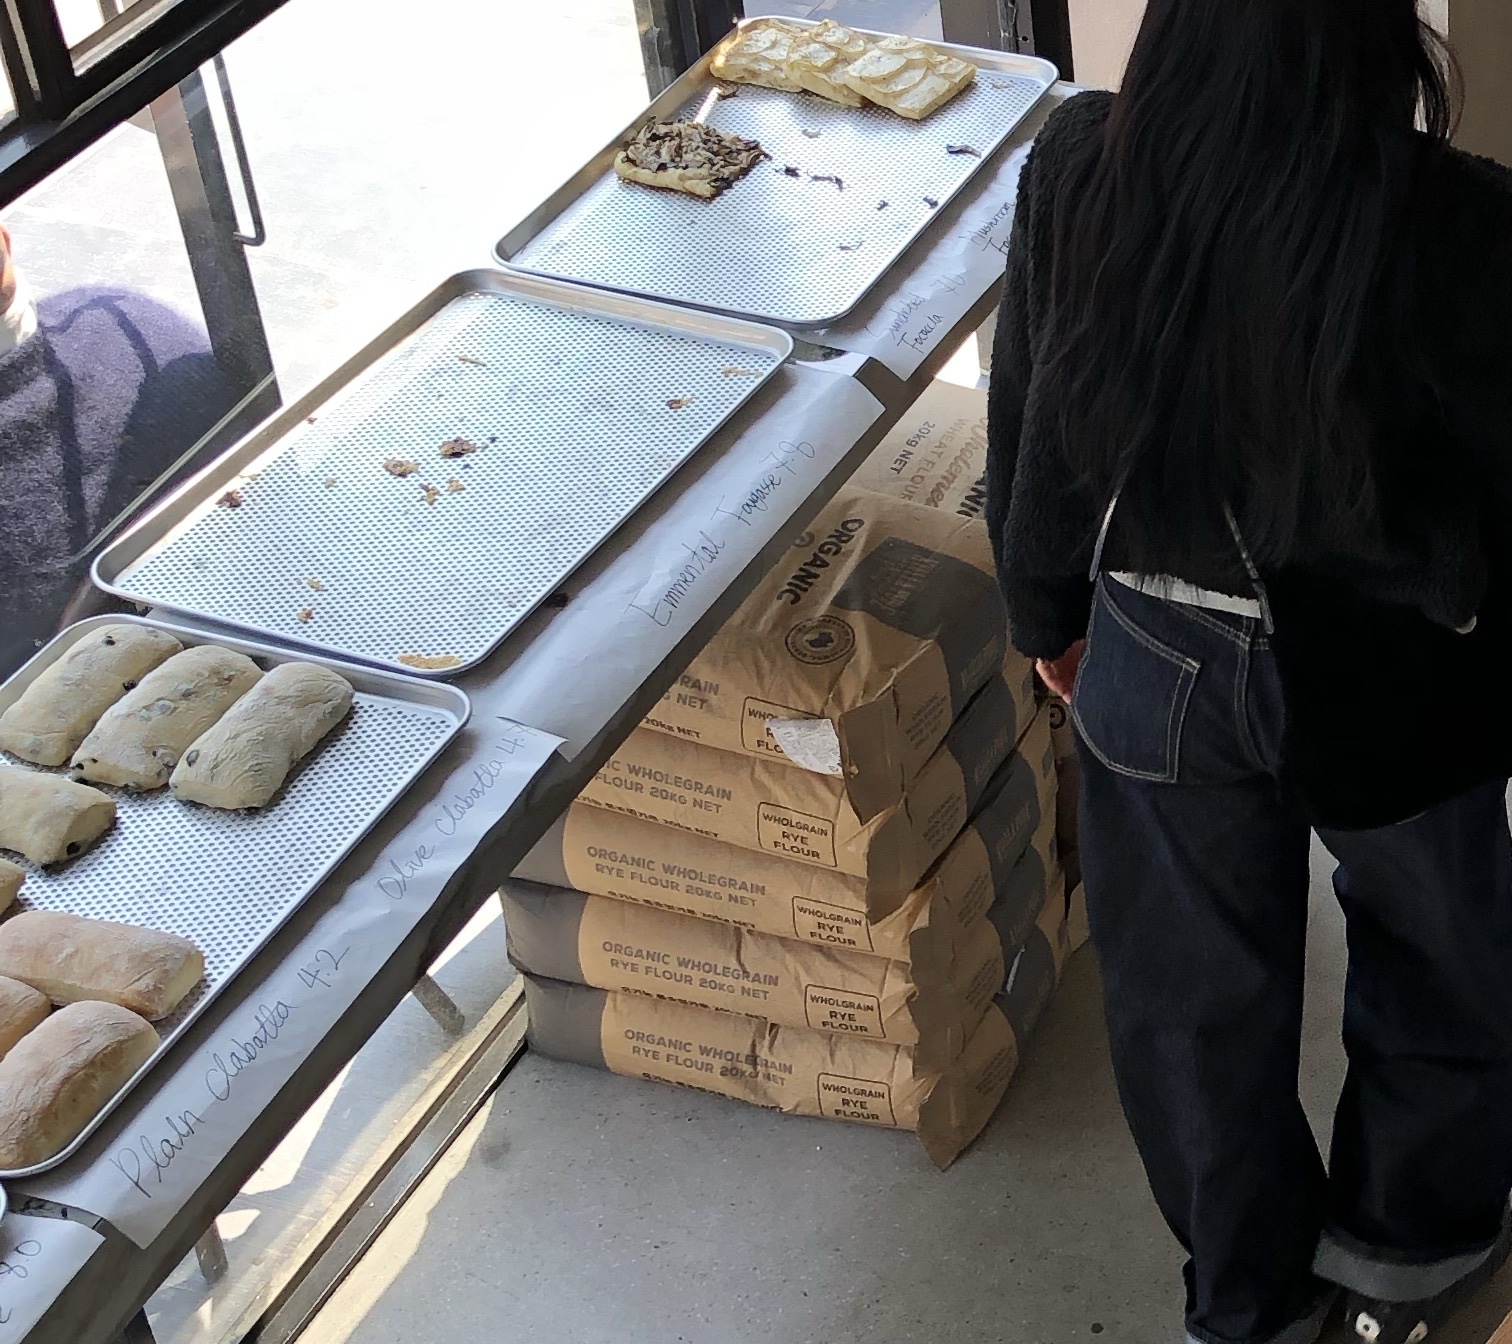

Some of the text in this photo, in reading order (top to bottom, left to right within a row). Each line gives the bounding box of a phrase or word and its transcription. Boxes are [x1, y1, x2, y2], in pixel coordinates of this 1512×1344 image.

[889, 420, 936, 475] 20kg NET
[775, 515, 867, 607] ORGANIC
[676, 693, 709, 711] NET
[626, 762, 733, 802] WHOLEGRAIN
[693, 797, 723, 815] NET
[773, 841, 821, 860] FLOUR
[781, 831, 810, 846] RYE
[377, 841, 435, 901] Olive
[586, 845, 767, 897] ORGANIC WHOLEGRAIN
[594, 862, 626, 879] RYE
[629, 871, 681, 893] FLOUR
[728, 894, 758, 909] NET
[809, 930, 857, 947] FLOUR
[816, 921, 845, 935] RYE
[601, 940, 780, 988] ORGANIC WHOLEGRAIN
[609, 957, 639, 974] RYE
[644, 965, 694, 986] FLOUR
[740, 986, 770, 1001] NET
[821, 1019, 869, 1034] FLOUR
[828, 1009, 857, 1023] RYE
[110, 1104, 206, 1200] Plain
[298, 944, 352, 1006] 4.2
[623, 1028, 794, 1076] ORGANIC WHOLEGRAIN
[631, 1045, 661, 1062] RYE
[666, 1053, 715, 1076] FLOUR
[762, 1071, 786, 1088] NET
[834, 1108, 881, 1122] FLOUR
[840, 1097, 868, 1111] RYE
